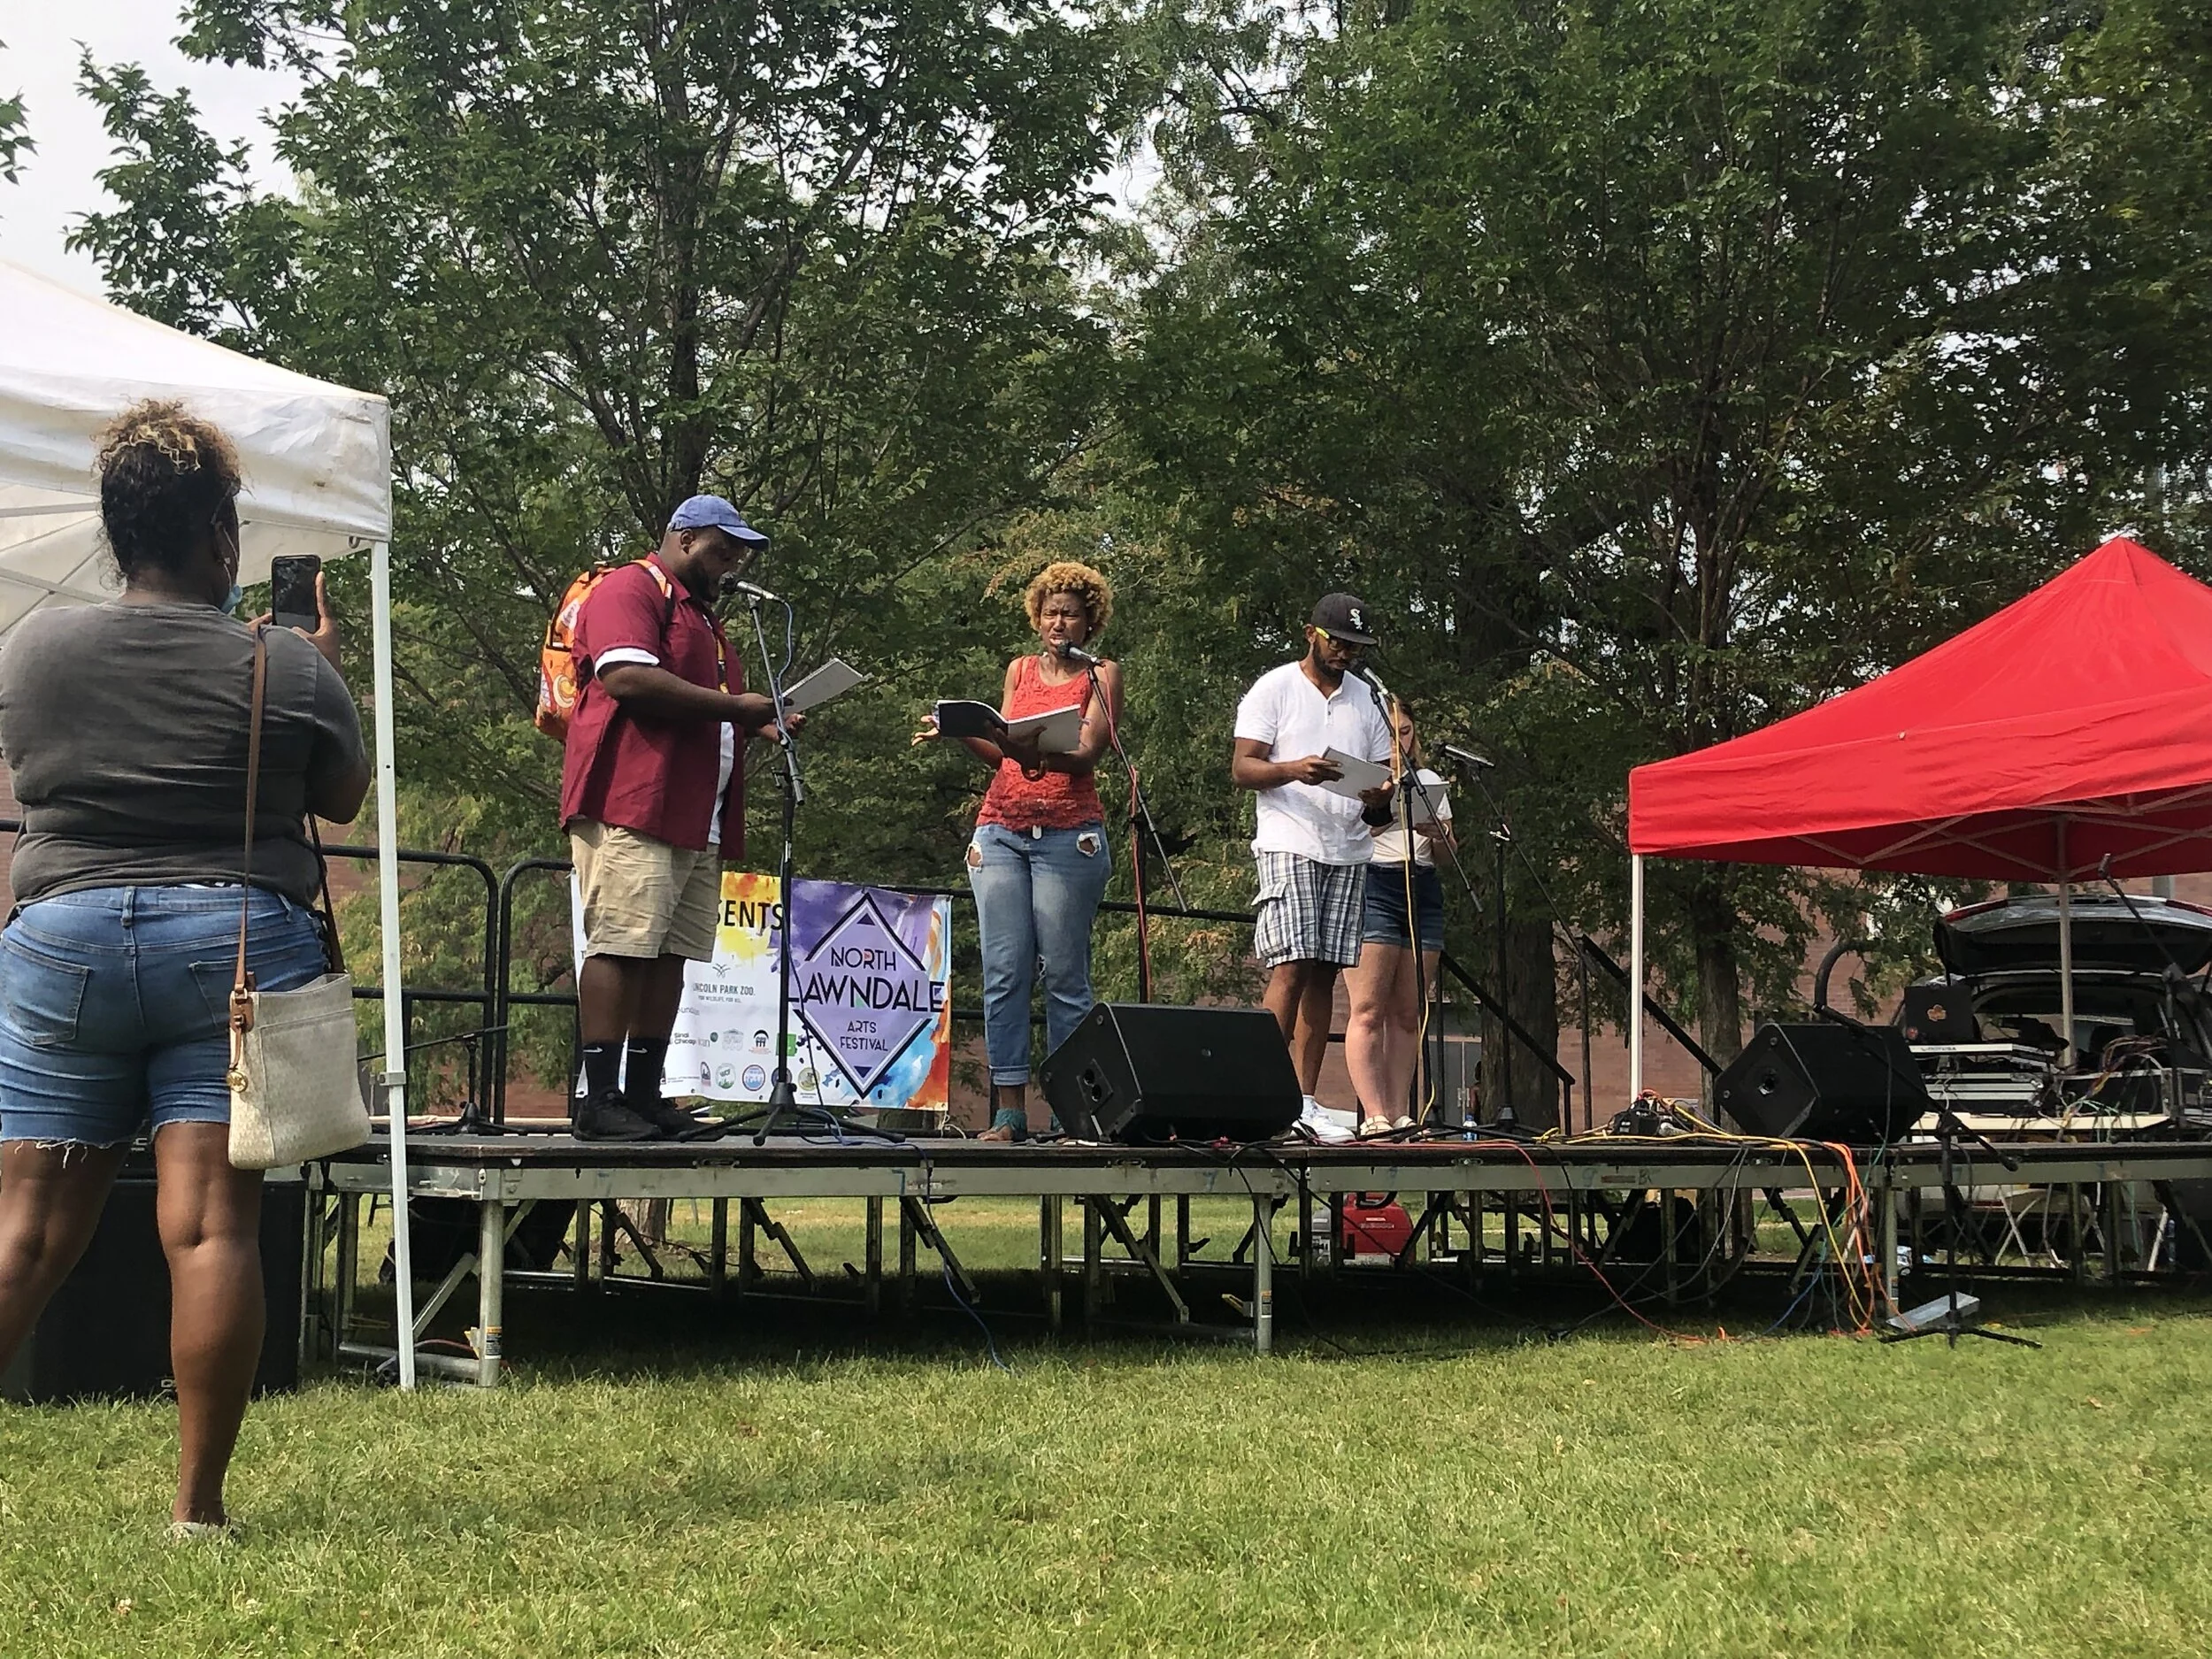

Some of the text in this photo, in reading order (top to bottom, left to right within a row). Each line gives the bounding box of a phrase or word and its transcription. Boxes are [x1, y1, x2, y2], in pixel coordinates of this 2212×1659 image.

[830, 946, 896, 972] NORTH
[720, 984, 738, 995] PARK
[847, 1020, 877, 1033] ARTS
[840, 1036, 888, 1051] FESTIVAL
